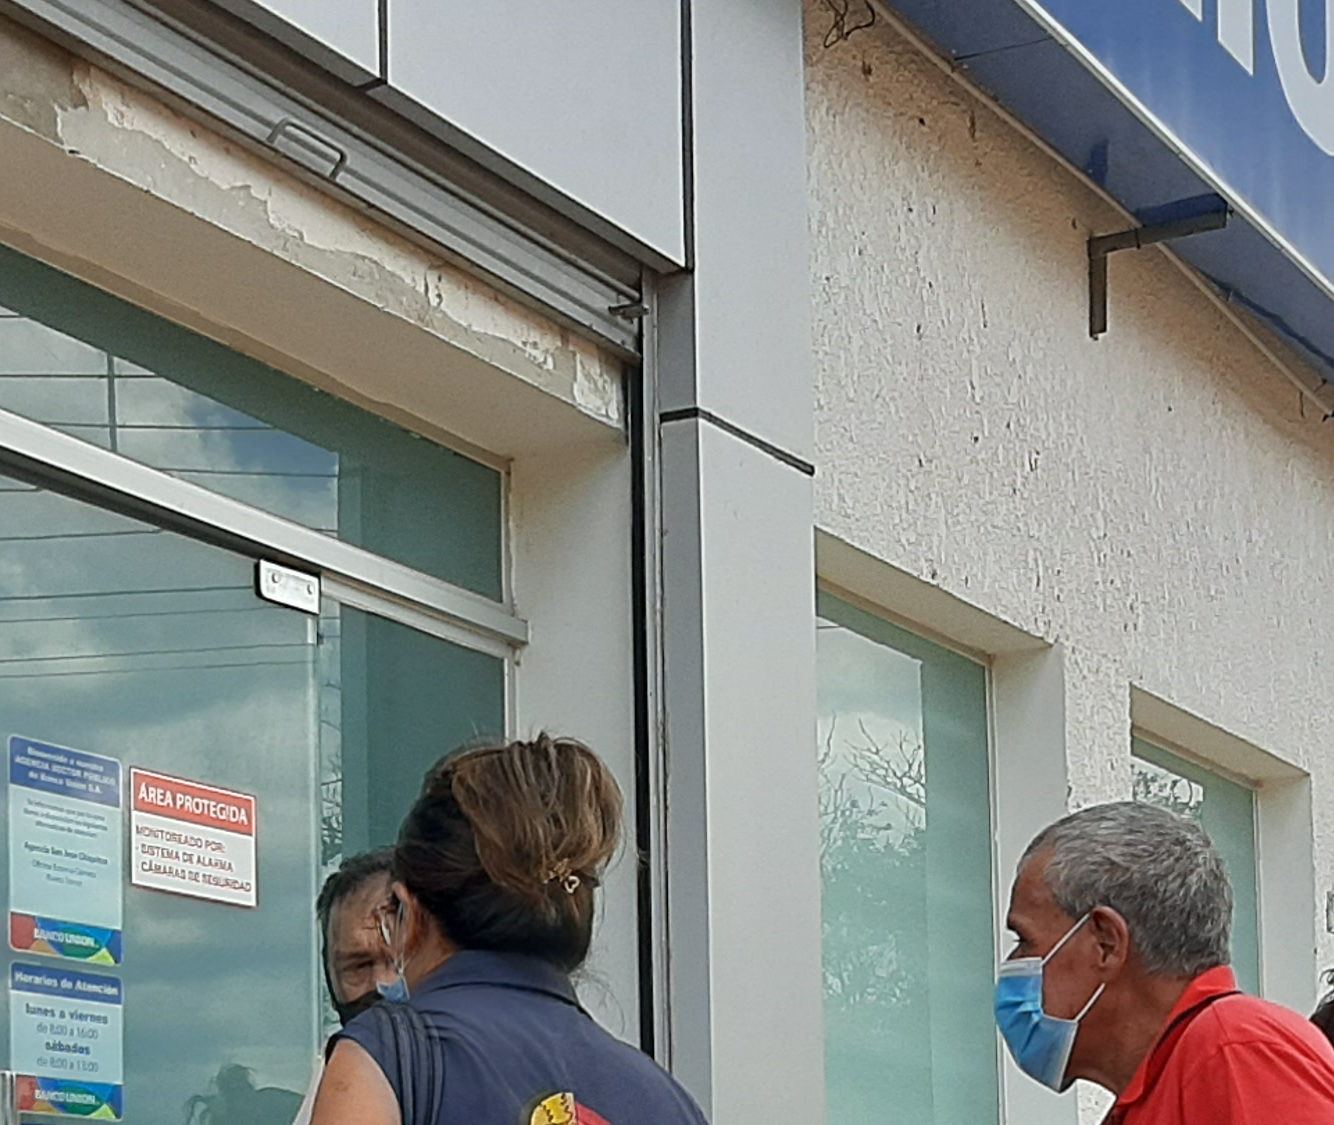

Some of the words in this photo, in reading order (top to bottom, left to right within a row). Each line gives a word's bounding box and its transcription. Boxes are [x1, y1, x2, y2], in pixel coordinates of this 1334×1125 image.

[138, 782, 173, 808] ÁREA
[176, 793, 249, 825] PROTEGIDA
[136, 824, 203, 849] MONITOREADO
[141, 843, 180, 861] SISTEMA
[182, 852, 194, 864] DE
[196, 855, 234, 872] ALARMA
[188, 870, 200, 883] DE
[202, 873, 252, 892] SEGURIDAD
[14, 971, 58, 987] Horarios
[61, 977, 72, 989] de
[75, 979, 118, 995] Atención
[26, 1003, 56, 1018] lunes
[59, 1010, 66, 1019] a
[68, 1009, 108, 1025] viernes
[45, 1041, 91, 1055] sábados
